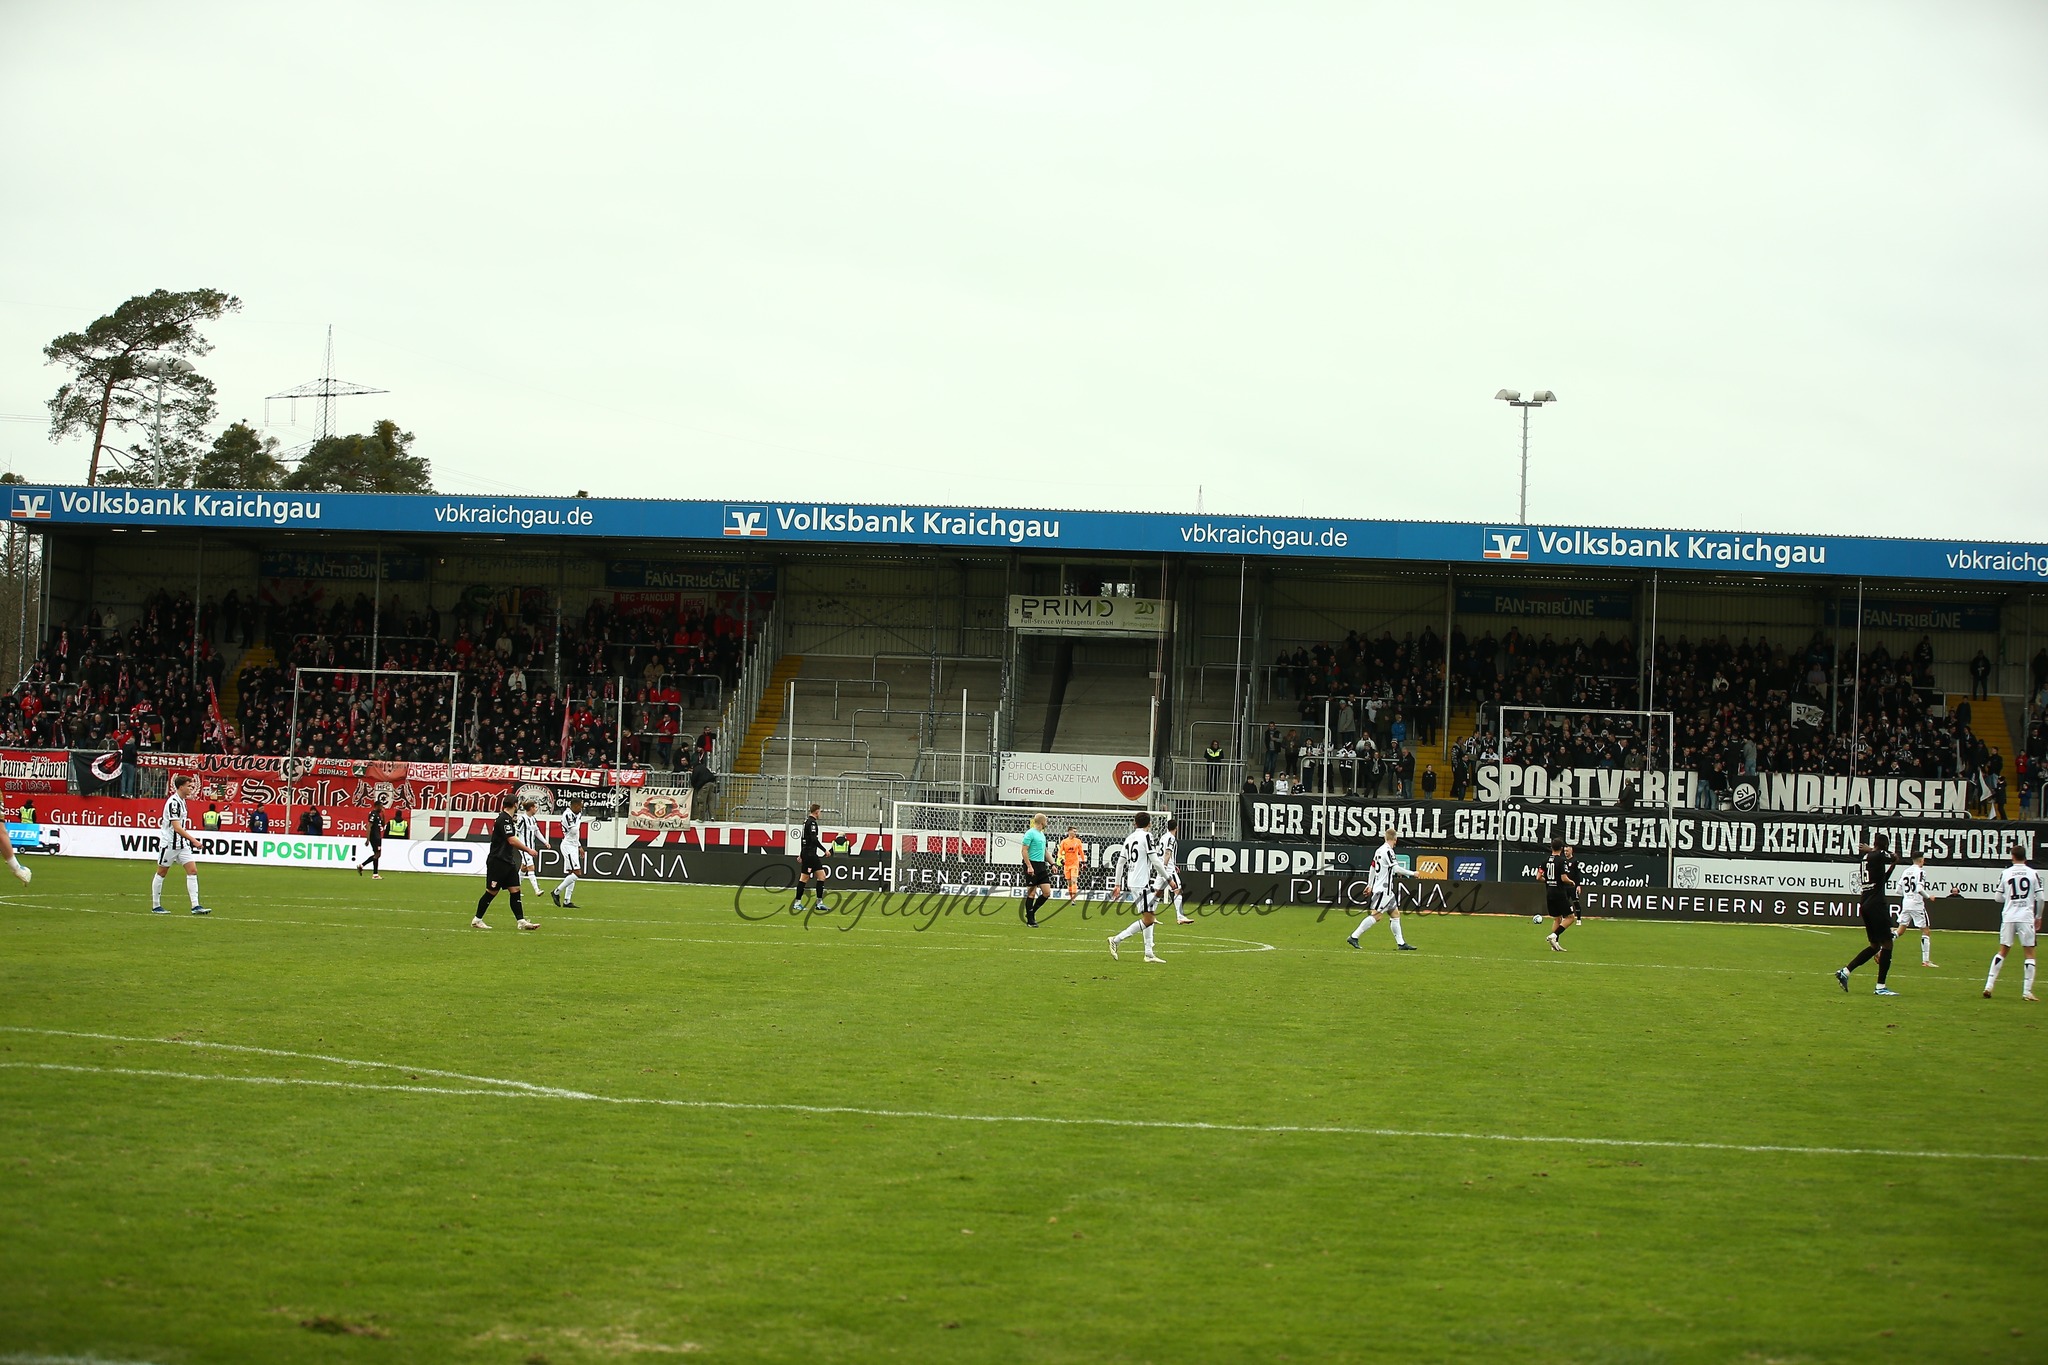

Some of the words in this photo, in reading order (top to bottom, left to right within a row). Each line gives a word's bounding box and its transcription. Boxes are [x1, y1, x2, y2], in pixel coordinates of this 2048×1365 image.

[59, 491, 187, 516] Volksbank
[193, 494, 322, 524] Kraichgau
[433, 503, 594, 528] vbkraichgau.de
[775, 507, 914, 534] Volksbank
[922, 511, 1060, 543] Kraichgau
[1179, 524, 1348, 550] vbkraichgau.de
[1536, 530, 1680, 559] Volksbank
[1686, 535, 1827, 568] Kraichgau
[620, 593, 635, 603] HFC
[640, 594, 675, 603] FANCLUB
[1494, 595, 1595, 617] FAN-TRIBÜNE
[1862, 608, 1961, 629] FAN-TRIBÜNE
[0, 753, 67, 778] euna-Löwen
[137, 755, 191, 767] STENDAL
[521, 765, 601, 786] SURREALE
[1026, 773, 1044, 782] DAS
[1046, 774, 1075, 783] GANZE
[1076, 775, 1100, 784] TEAM
[1477, 763, 1699, 809] SPORTVEREI
[636, 787, 688, 796] FANCLUB
[1007, 786, 1055, 796] officemix.de
[1736, 786, 1750, 799] SV
[50, 809, 78, 825] Gut
[81, 808, 105, 826] für
[111, 811, 132, 827] die
[1252, 802, 1304, 835] DER
[1310, 804, 1447, 839] FUSSBALL
[1454, 803, 1558, 845] GEHÖRT
[1564, 815, 1618, 847] UNS
[1623, 817, 1695, 850] FANS
[1701, 820, 1757, 852] UND
[1762, 822, 1863, 856] KEINEN
[1868, 826, 2036, 860] INVESTOREN
[120, 834, 161, 853] WIR
[262, 841, 357, 862] POSITIV!
[423, 847, 473, 868] GP
[1124, 841, 1139, 863] 16
[538, 849, 689, 879] PICANA
[1546, 862, 1555, 880] 20
[1861, 860, 1870, 883] 15
[1704, 873, 1775, 886] REICHSRAT
[1778, 876, 1808, 887] VON
[1810, 877, 1844, 888] BUHL
[1903, 876, 1916, 894] 36
[1950, 882, 1978, 893] VON
[2007, 877, 2031, 900] 19
[1290, 877, 1447, 908] PLICNA
[1587, 893, 1763, 915] FIRMENFEIERN
[1773, 900, 1786, 915] &
